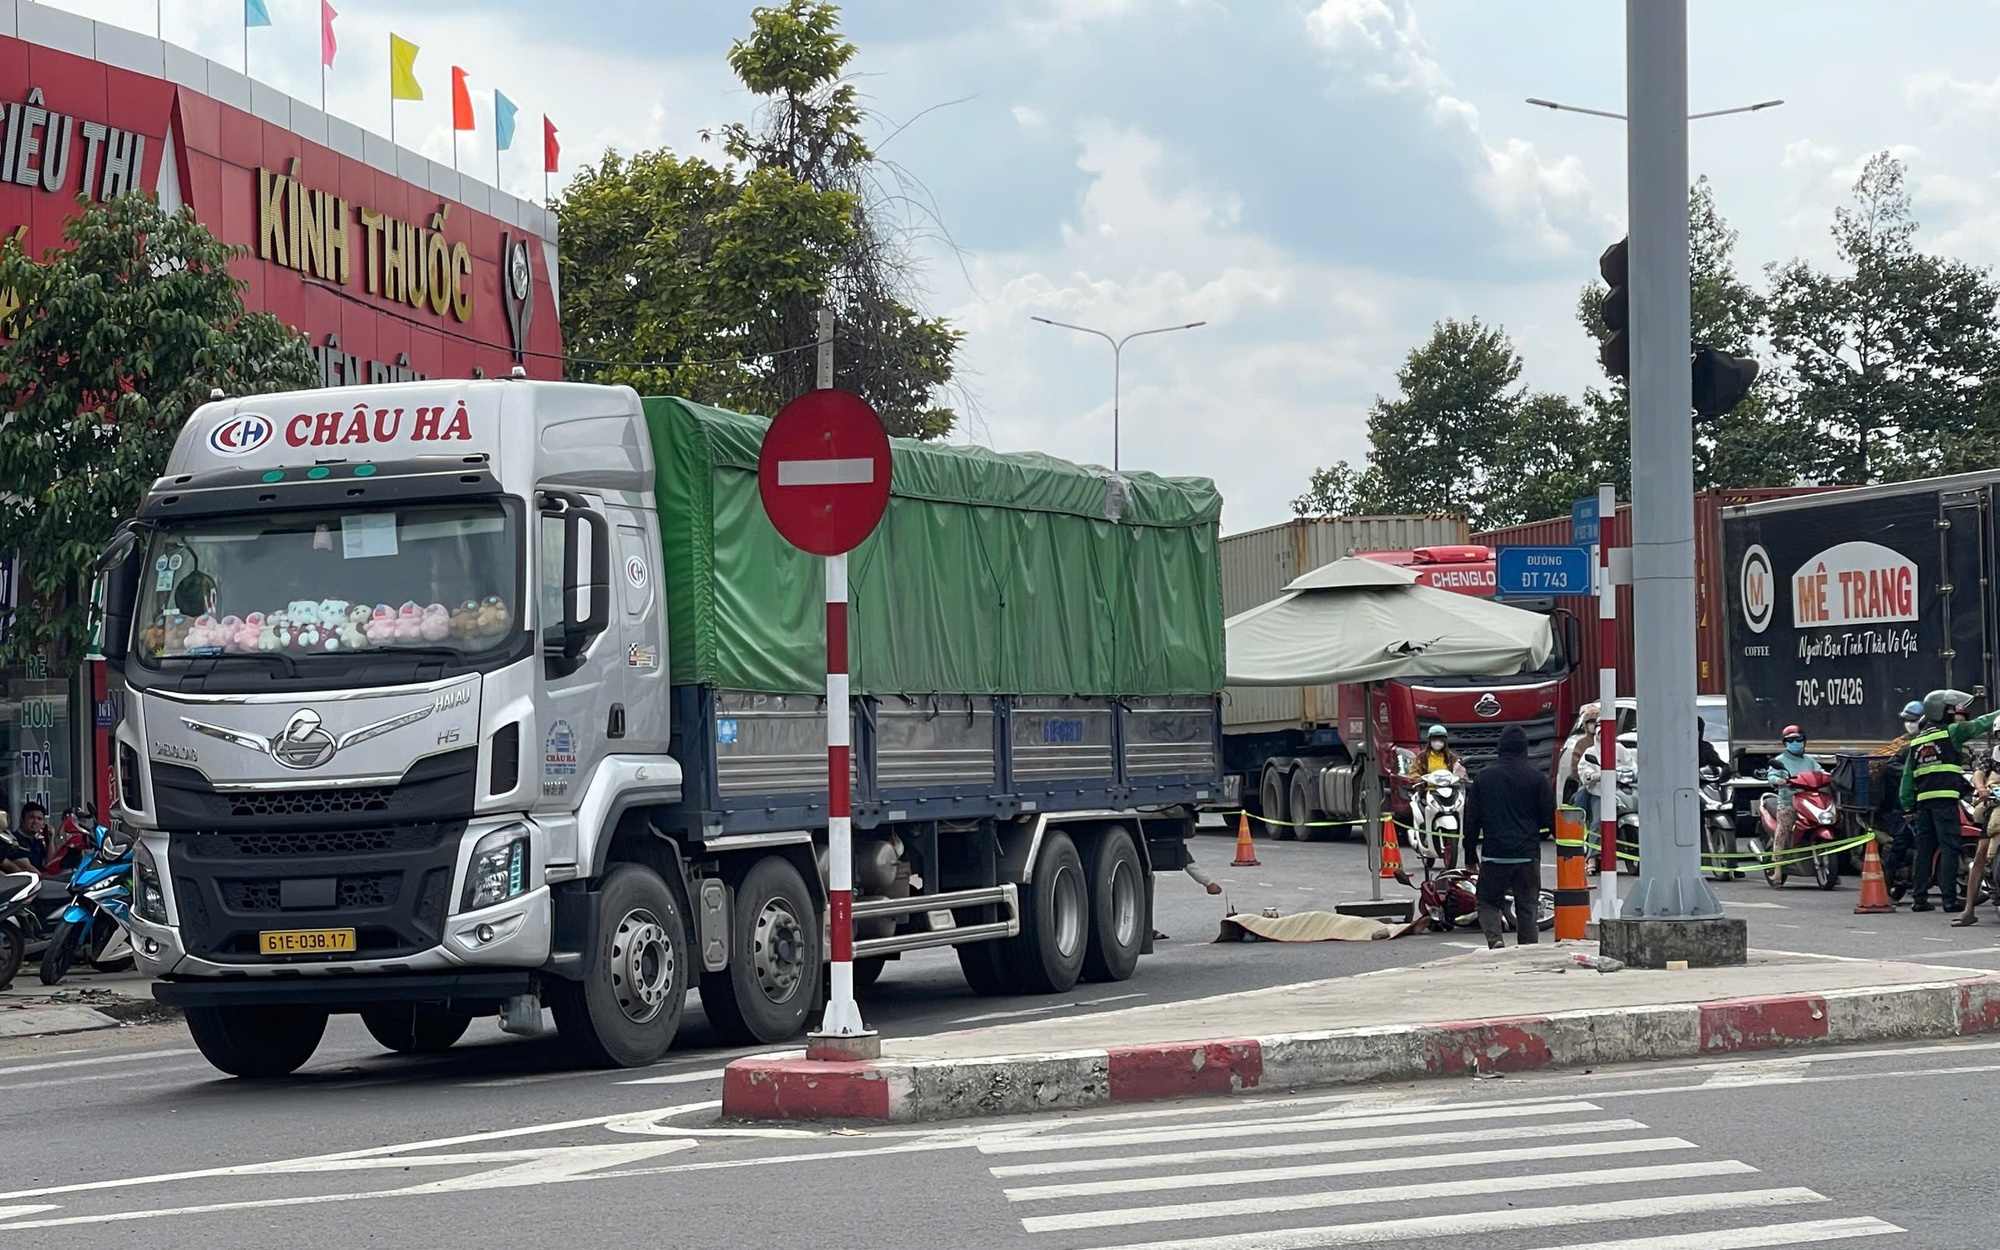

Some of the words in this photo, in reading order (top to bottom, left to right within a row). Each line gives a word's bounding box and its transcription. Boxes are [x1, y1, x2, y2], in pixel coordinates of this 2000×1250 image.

[256, 157, 349, 285] KÍNH
[357, 203, 472, 324] THUỐC
[285, 403, 404, 447] CHÂU
[410, 400, 472, 441] HÀ
[1527, 554, 1562, 566] ĐƯỜNG
[1522, 572, 1541, 587] ĐT
[1544, 572, 1567, 588] 743
[1798, 561, 1829, 622] MÊ
[1839, 566, 1912, 619] TRANG
[1745, 646, 1770, 656] COFFEE
[1824, 634, 1841, 659] Bạn
[1901, 629, 1918, 658] Giá
[21, 698, 53, 728] HƠN
[21, 740, 52, 777] TRẢ
[268, 933, 347, 950] 61E-038.17
